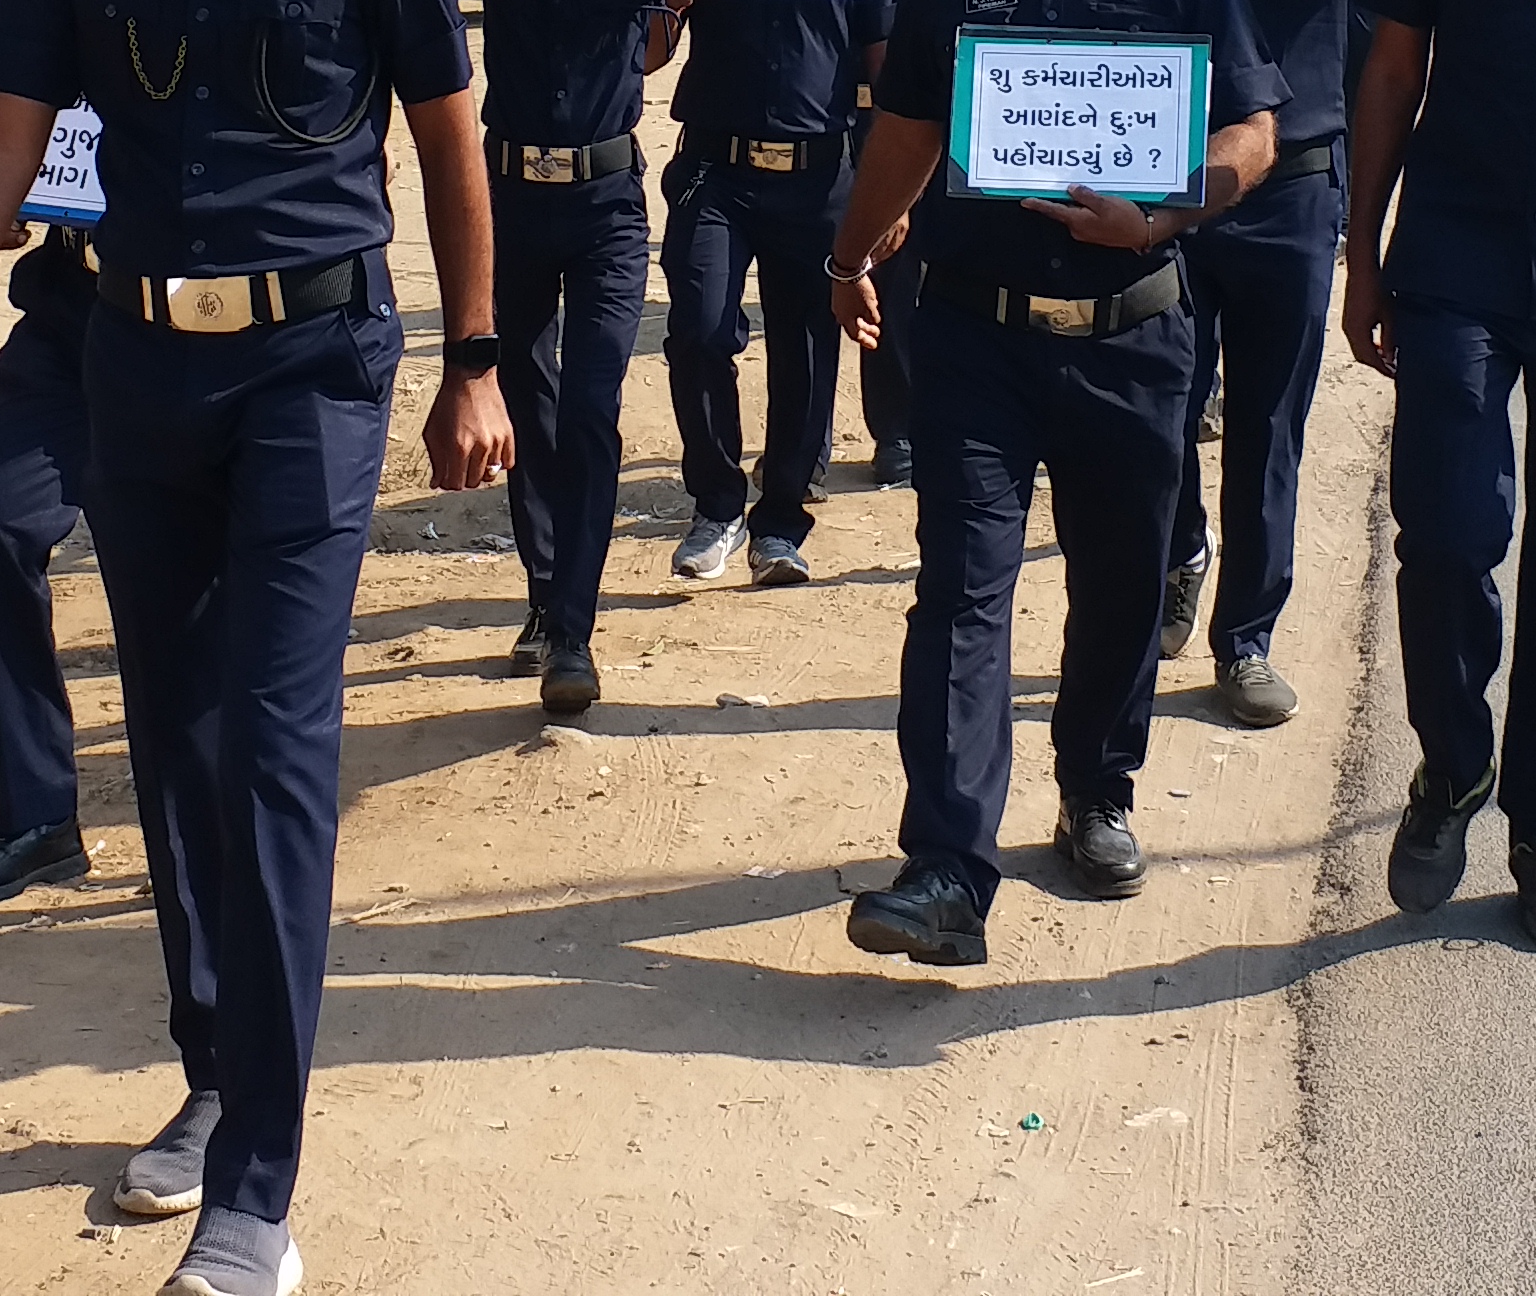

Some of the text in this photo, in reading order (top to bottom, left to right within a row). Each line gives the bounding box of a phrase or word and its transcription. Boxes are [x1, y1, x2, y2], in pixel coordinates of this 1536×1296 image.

[989, 63, 1173, 93] શુ કર્મચારીઓએ
[1002, 102, 1156, 135] આણંદને દુઃખ
[1113, 144, 1133, 167] છે
[1148, 148, 1162, 169] ?
